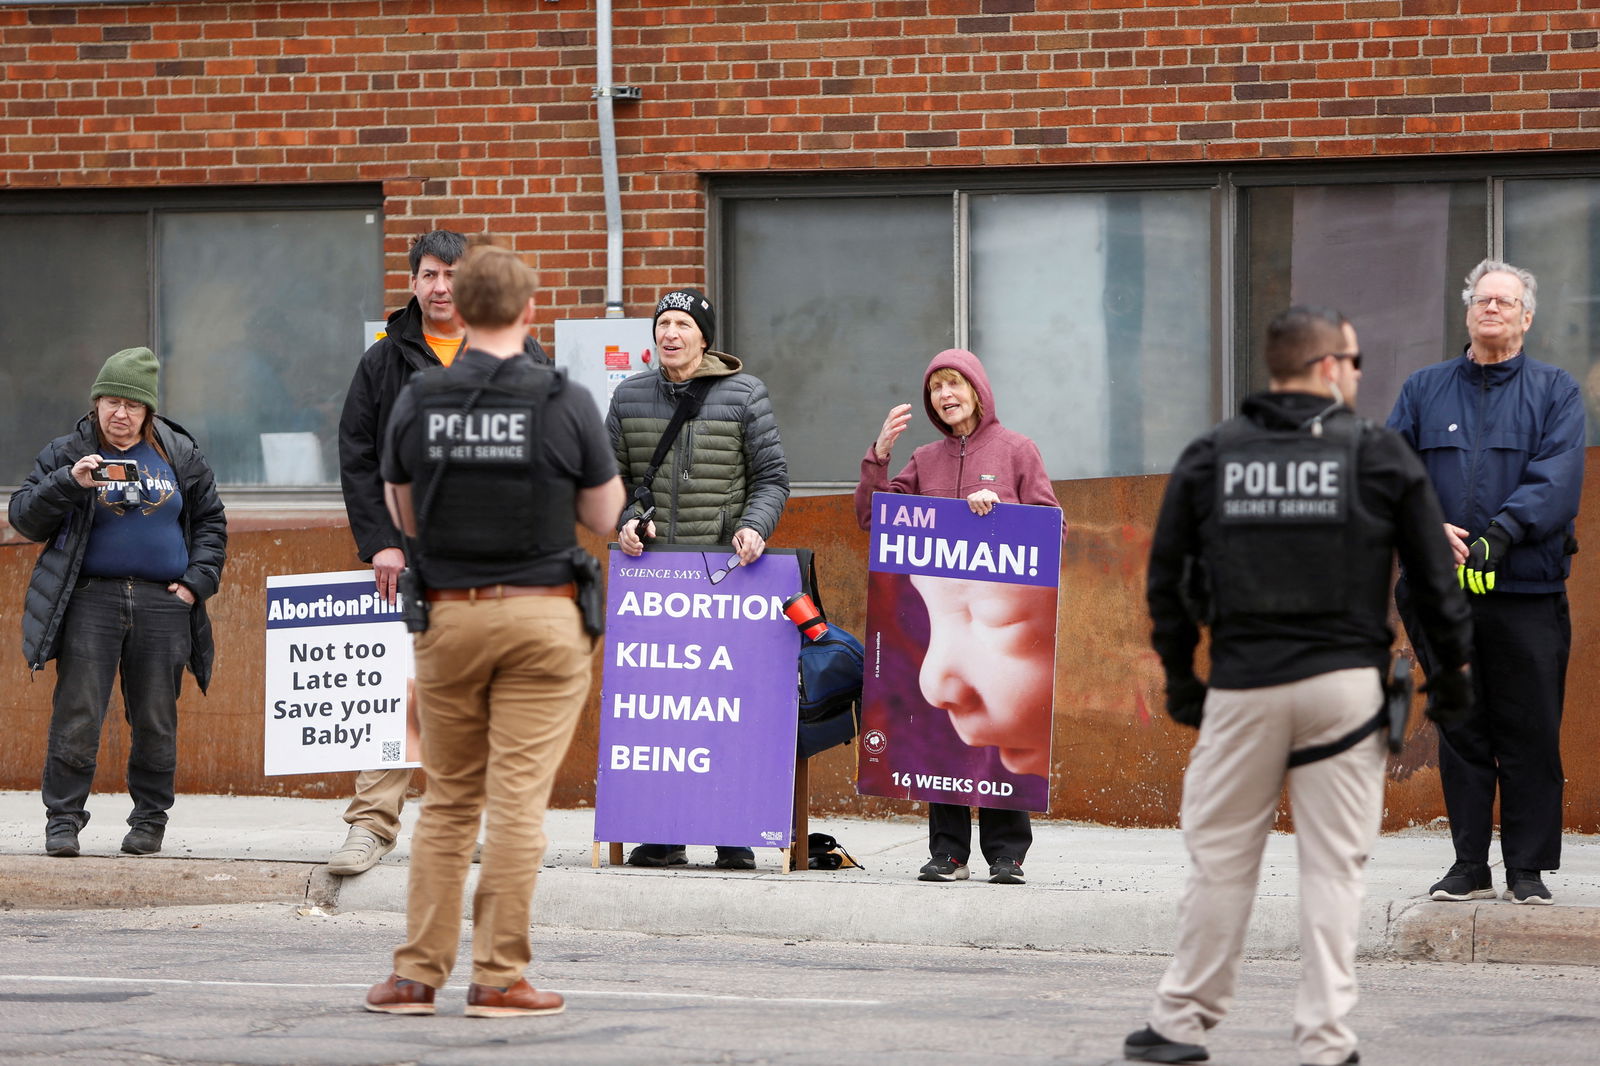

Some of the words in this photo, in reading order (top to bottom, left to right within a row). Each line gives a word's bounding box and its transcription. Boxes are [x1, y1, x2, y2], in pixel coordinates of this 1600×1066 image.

[428, 413, 526, 441] POLICE
[428, 446, 471, 458] SERET
[475, 446, 524, 458] SERVICE
[146, 478, 173, 491] PAIR
[1223, 461, 1340, 496] POLICE
[880, 503, 887, 525] I
[892, 505, 937, 529] AM
[1225, 500, 1276, 515] SECRET
[1279, 500, 1337, 515] SERVICE
[879, 533, 1039, 577] HUMAN!
[619, 567, 671, 579] SCIENCE
[617, 591, 792, 621] ABORTION
[289, 643, 336, 663] Not
[344, 642, 386, 660] too
[616, 642, 702, 670] KILLS
[708, 645, 734, 671] A
[292, 671, 348, 691] Late
[356, 669, 382, 687] to
[273, 700, 333, 720] Save
[341, 697, 401, 722] your
[613, 693, 741, 723] HUMAN
[302, 723, 372, 749] Baby!
[610, 745, 711, 774] BEING
[891, 771, 912, 787] 16
[915, 774, 974, 793] WEEKS
[977, 780, 1014, 797] OLD
